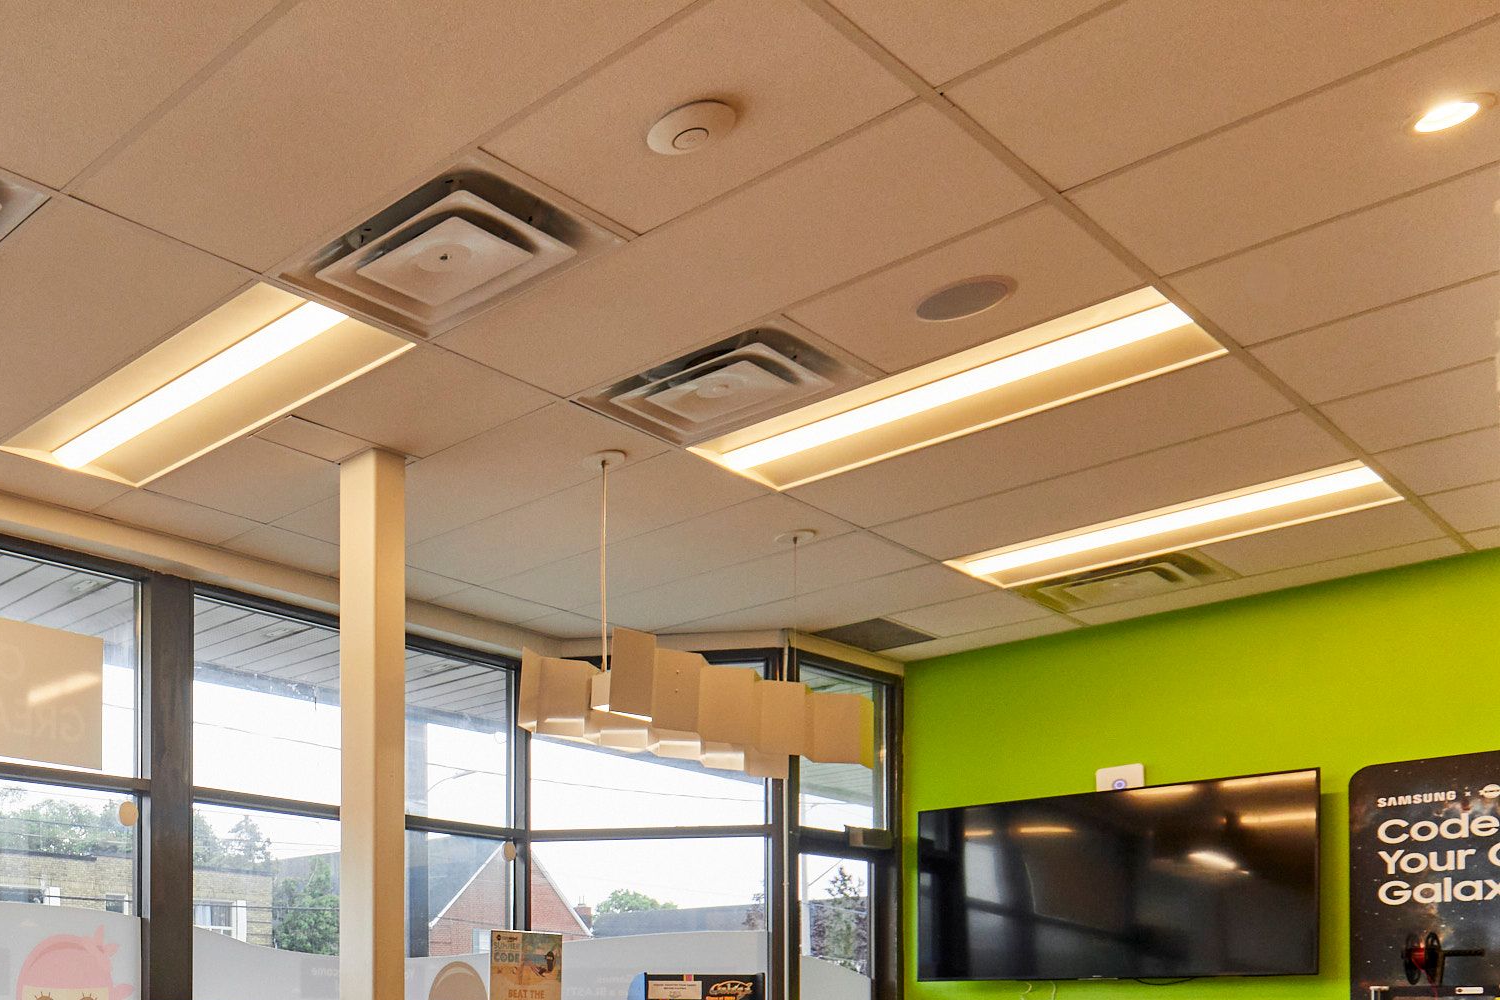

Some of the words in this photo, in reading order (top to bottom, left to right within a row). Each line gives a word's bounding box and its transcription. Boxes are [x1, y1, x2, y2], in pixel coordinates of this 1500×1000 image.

[1377, 790, 1457, 808] SAMSUNG
[1377, 812, 1500, 844] Code
[1377, 848, 1477, 875] Your
[1378, 877, 1500, 905] Galax
[493, 951, 520, 963] CODE
[508, 989, 527, 999] BEAT
[530, 990, 545, 999] THE
